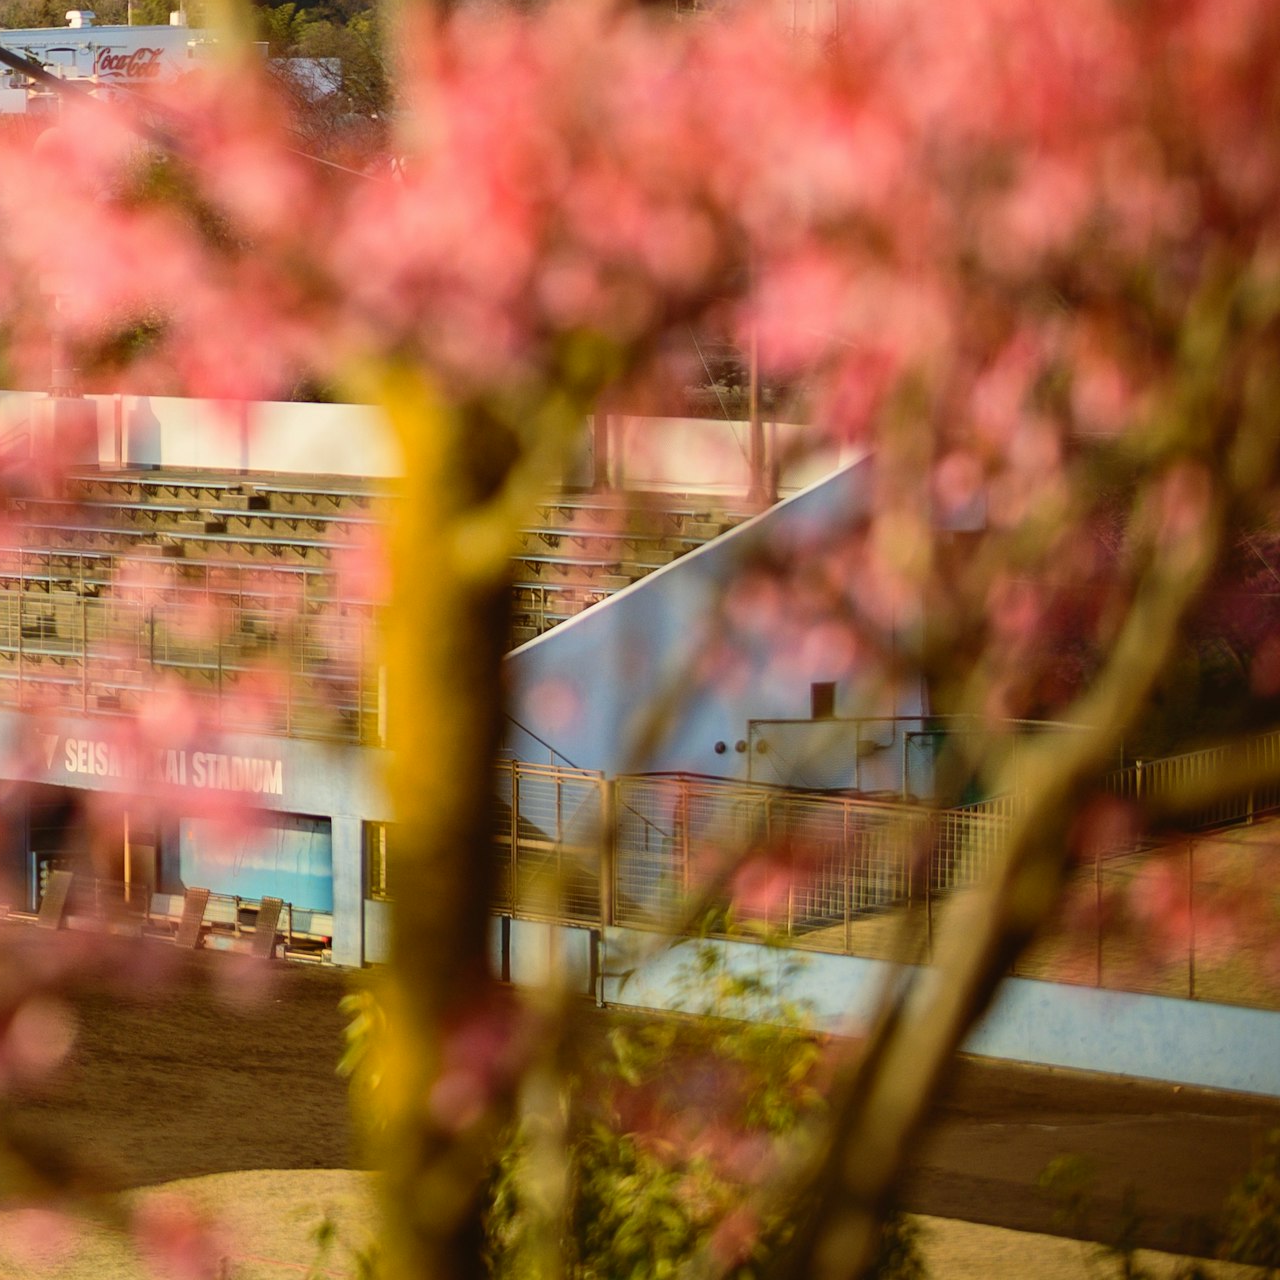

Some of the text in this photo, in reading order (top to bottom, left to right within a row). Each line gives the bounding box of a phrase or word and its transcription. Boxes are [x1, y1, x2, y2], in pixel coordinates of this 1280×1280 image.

[97, 47, 164, 78] Coca-Cola
[64, 737, 122, 777] SEISA
[191, 751, 283, 795] STADIUM
